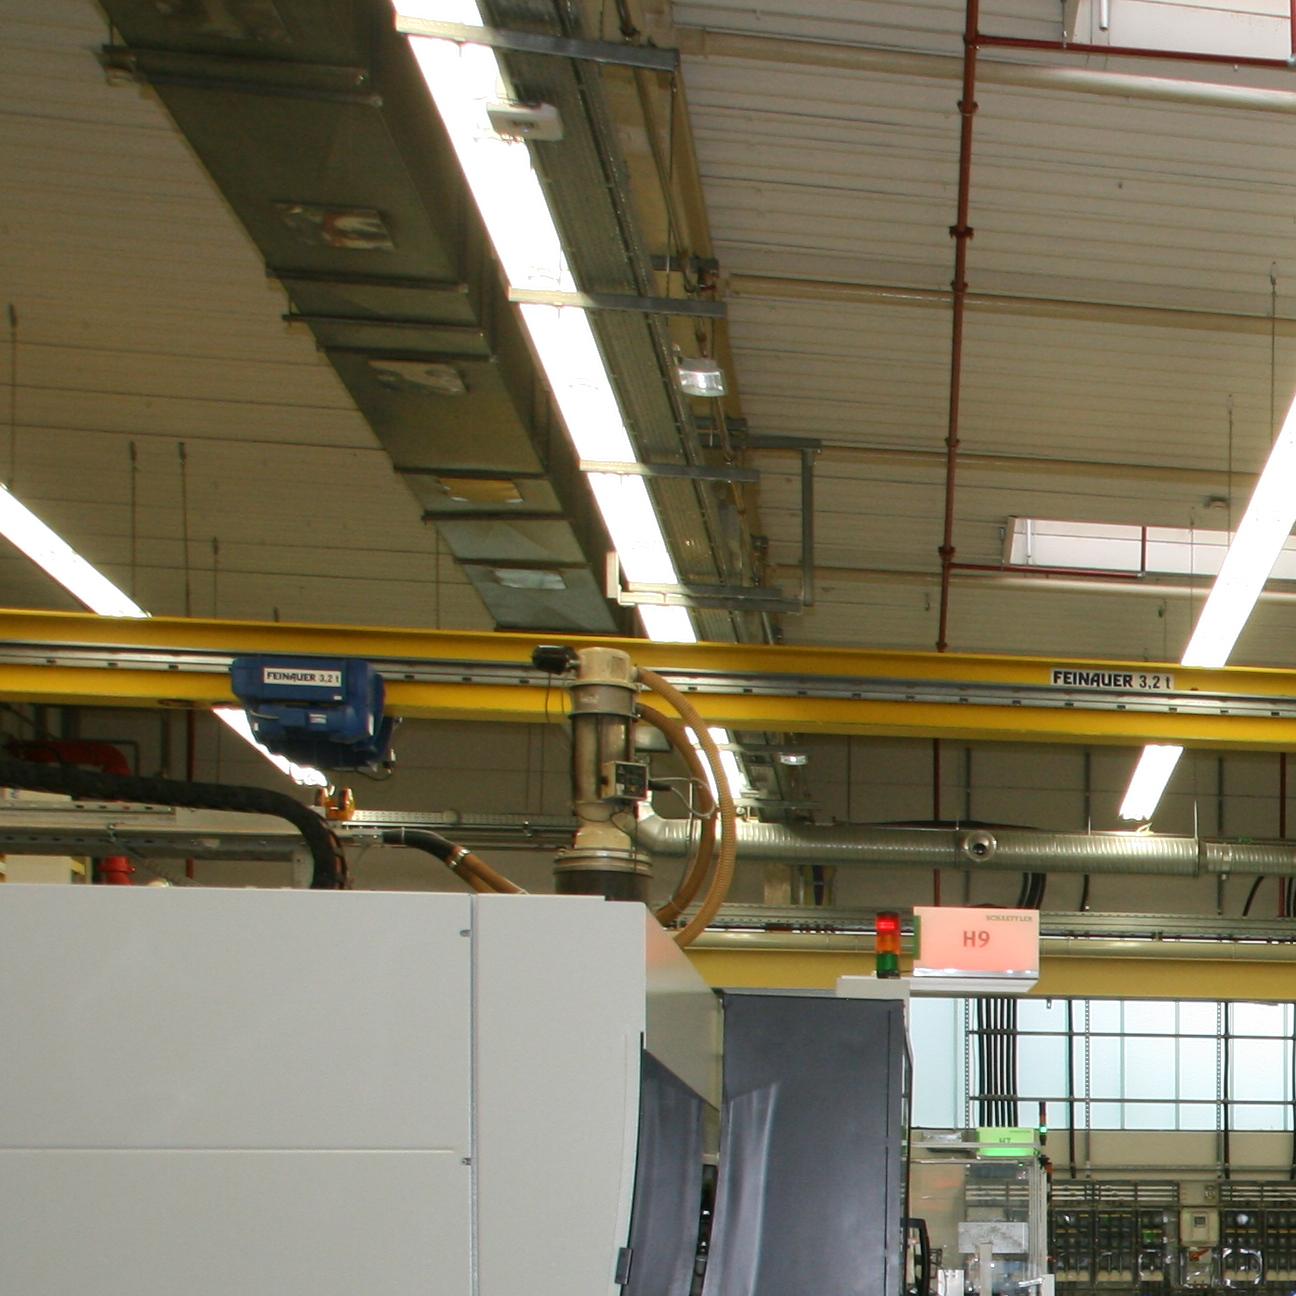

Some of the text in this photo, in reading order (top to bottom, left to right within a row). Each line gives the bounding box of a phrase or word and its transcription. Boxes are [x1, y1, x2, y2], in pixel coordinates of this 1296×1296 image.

[266, 671, 317, 684] FEINAUER
[1052, 670, 1134, 688] FEINAUER
[1164, 674, 1171, 690] t
[963, 930, 991, 947] H9
